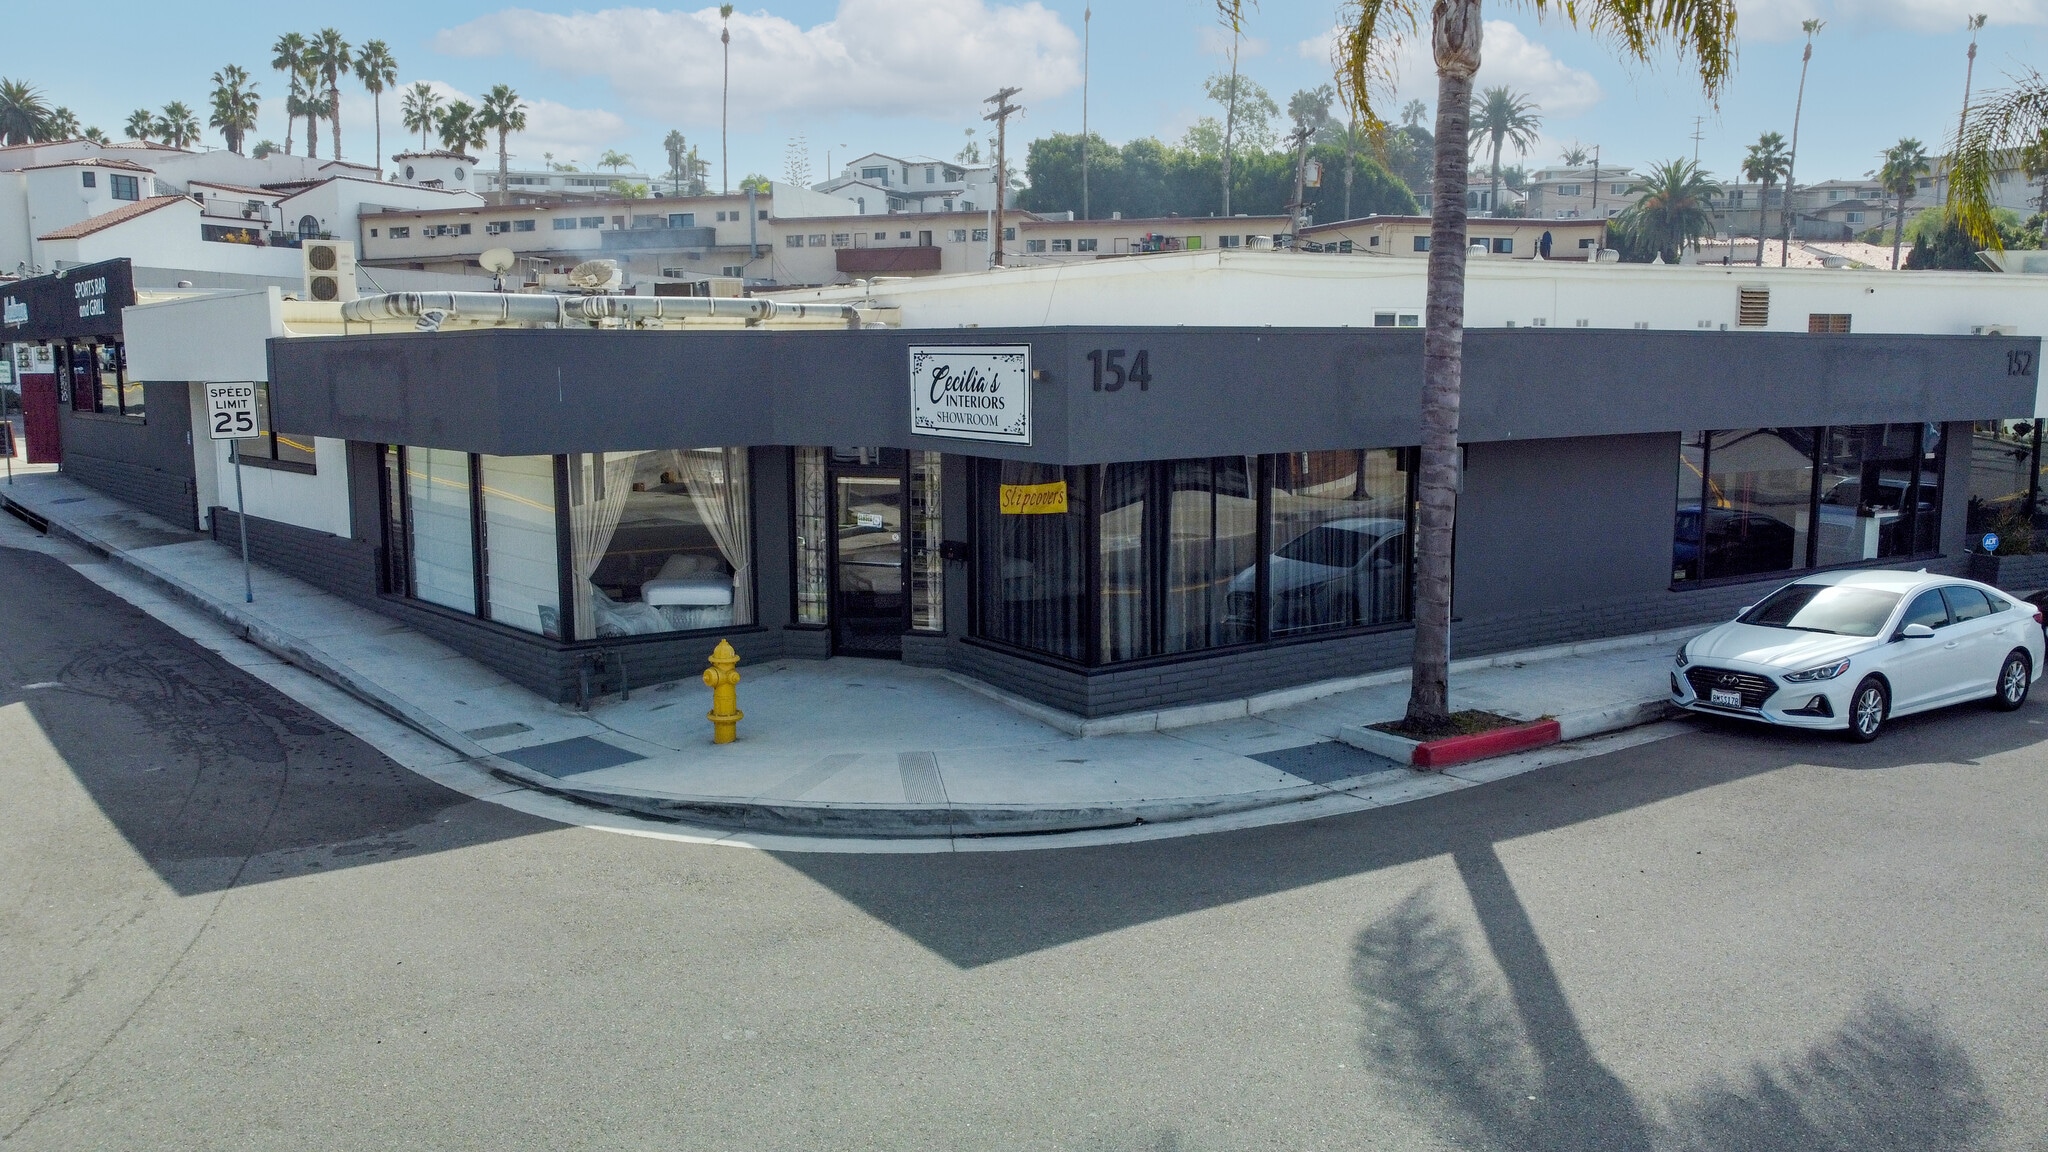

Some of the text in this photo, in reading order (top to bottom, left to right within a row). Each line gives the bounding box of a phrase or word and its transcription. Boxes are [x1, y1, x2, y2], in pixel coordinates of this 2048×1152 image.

[74, 276, 107, 299] SPORTS BAR
[90, 298, 105, 316] GRILL
[1087, 349, 1152, 392] 154
[2007, 350, 2031, 376] 152
[210, 387, 252, 398] SPEED
[930, 364, 1001, 404] Cecilia's
[215, 399, 248, 410] LIMIT
[946, 394, 1005, 410] INTERIORS
[213, 411, 253, 433] 25
[936, 411, 999, 427] SHOWROOM
[1002, 487, 1064, 514] Slipcovers
